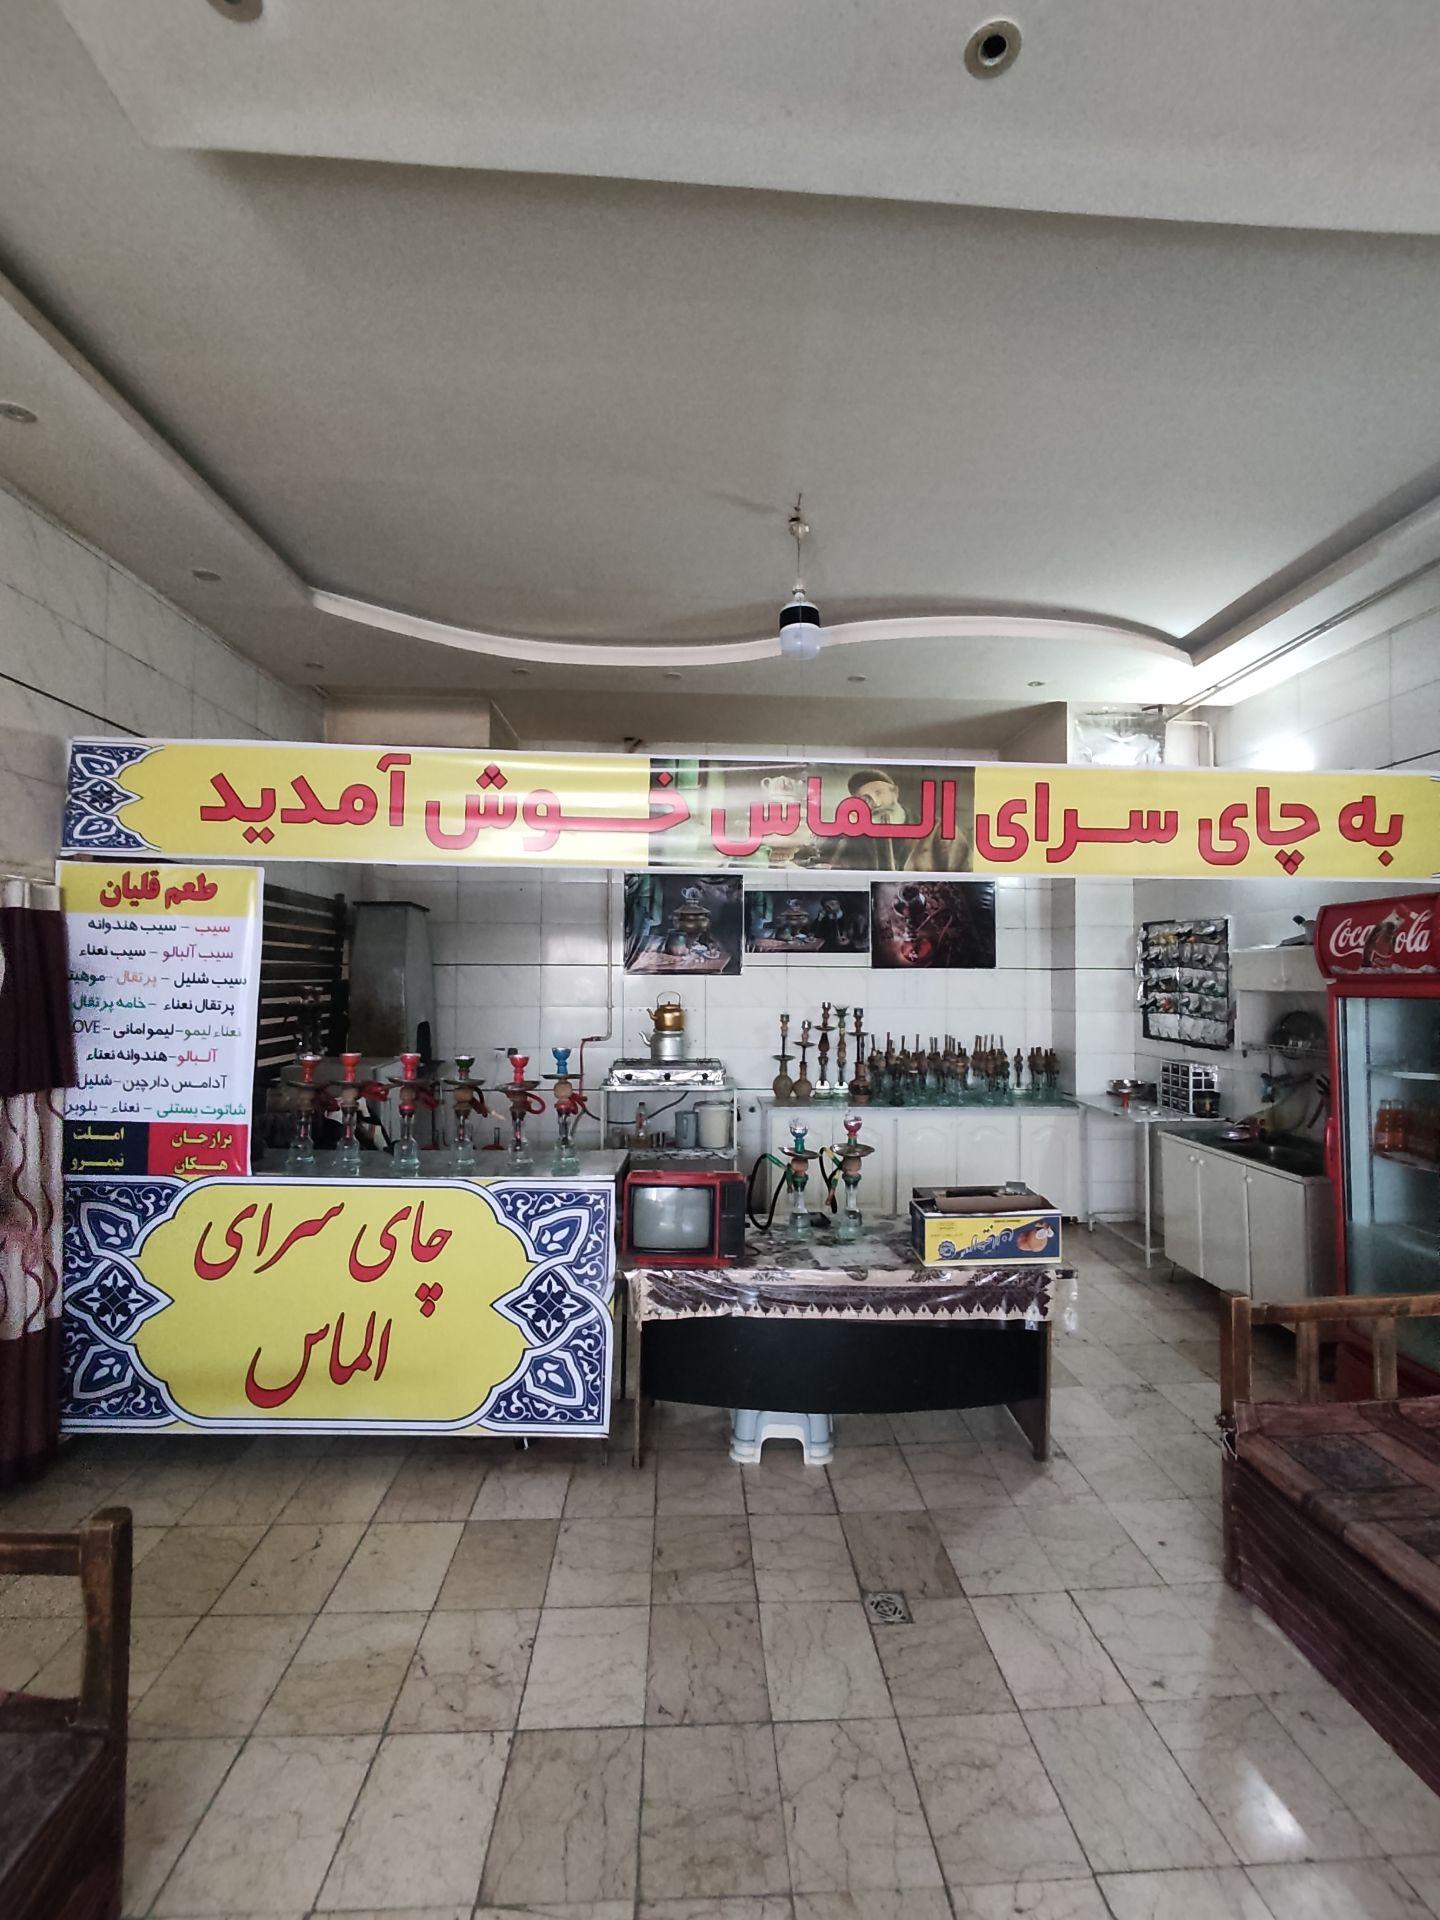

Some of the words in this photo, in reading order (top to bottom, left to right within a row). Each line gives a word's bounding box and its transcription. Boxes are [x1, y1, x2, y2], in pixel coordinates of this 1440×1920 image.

[200, 753, 411, 844] آمدید
[425, 764, 692, 852] خوش
[710, 777, 956, 857] الماس
[976, 782, 1178, 864] سرای
[1199, 787, 1320, 874] چای
[1339, 796, 1404, 866] به
[100, 870, 160, 907] قلیان
[165, 873, 218, 909] طعم
[88, 918, 137, 933] هندوانه
[140, 923, 176, 935] سیب
[195, 925, 230, 936] سیب
[1394, 909, 1431, 953] ola
[110, 949, 146, 960] سیب
[163, 944, 196, 962] آلبالو
[199, 951, 233, 963] سیب
[117, 971, 156, 987] پرتقال
[174, 972, 209, 988] شلیل
[212, 976, 247, 988] سیب
[73, 992, 114, 1012] پرتقال
[116, 996, 146, 1009] خامه
[195, 998, 234, 1016] پرتقال
[113, 1023, 145, 1038] امانی
[146, 1024, 174, 1040] لیمو
[183, 1025, 211, 1041] لیمو
[117, 1049, 168, 1065] هندوانه
[176, 1048, 218, 1067] آلبالو
[77, 1073, 112, 1089] شلیل
[123, 1075, 169, 1092] دارچین
[171, 1075, 227, 1092] آدامس
[157, 1104, 197, 1118] بستنی
[201, 1103, 246, 1119] شاتوت
[73, 1125, 124, 1141] املت
[70, 1154, 125, 1170] نیمرو
[173, 1157, 228, 1174] هکان
[194, 1202, 345, 1280] سرای
[349, 1201, 452, 1317] چای
[245, 1311, 392, 1408] الماس
